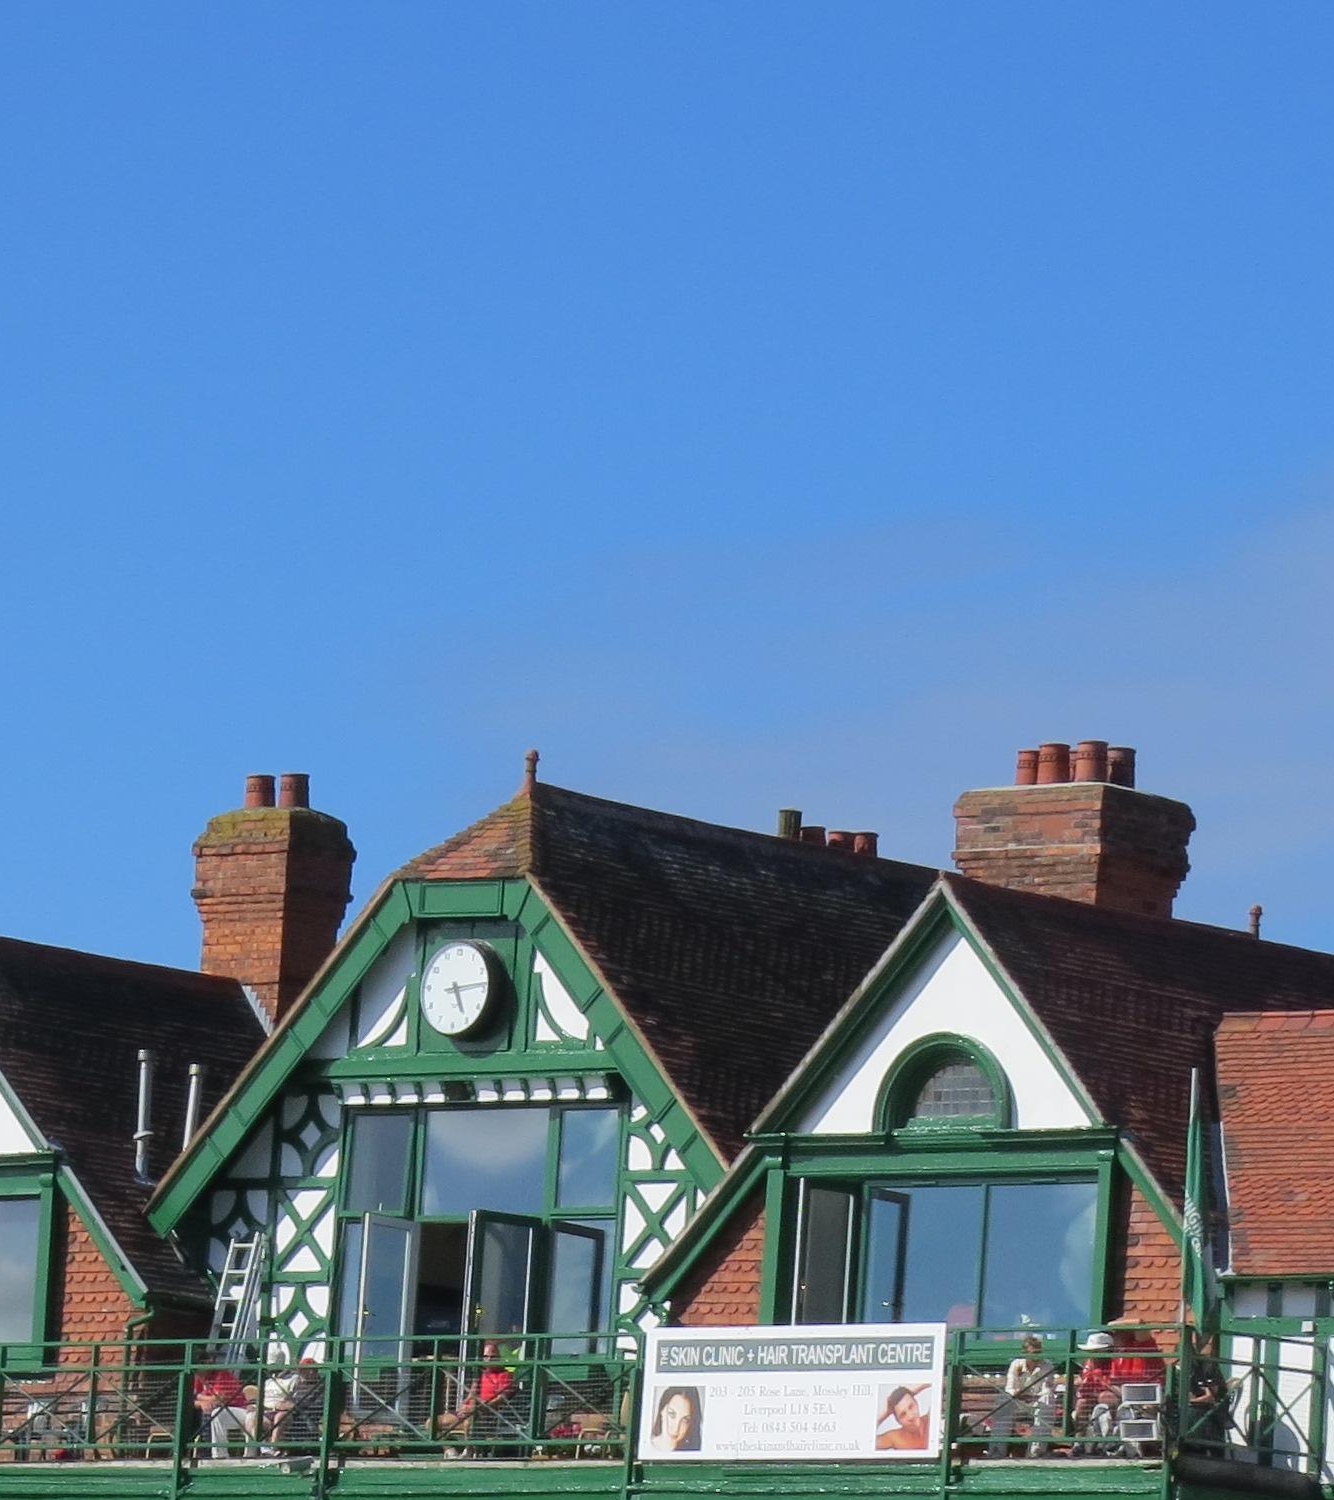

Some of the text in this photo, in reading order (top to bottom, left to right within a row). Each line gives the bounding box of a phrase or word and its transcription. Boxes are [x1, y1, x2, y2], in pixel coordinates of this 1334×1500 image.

[660, 1346, 669, 1367] THE
[670, 1342, 931, 1367] SKIN CLINIC + HAIR TRANSPLANT CENTRE
[709, 1385, 727, 1398] 203
[737, 1385, 756, 1398] 205
[759, 1385, 780, 1397] Rose
[812, 1384, 848, 1399] Mossley
[743, 1402, 836, 1418] Liverpool L18 5EA
[742, 1421, 836, 1433] Tel: 0843 504 4663
